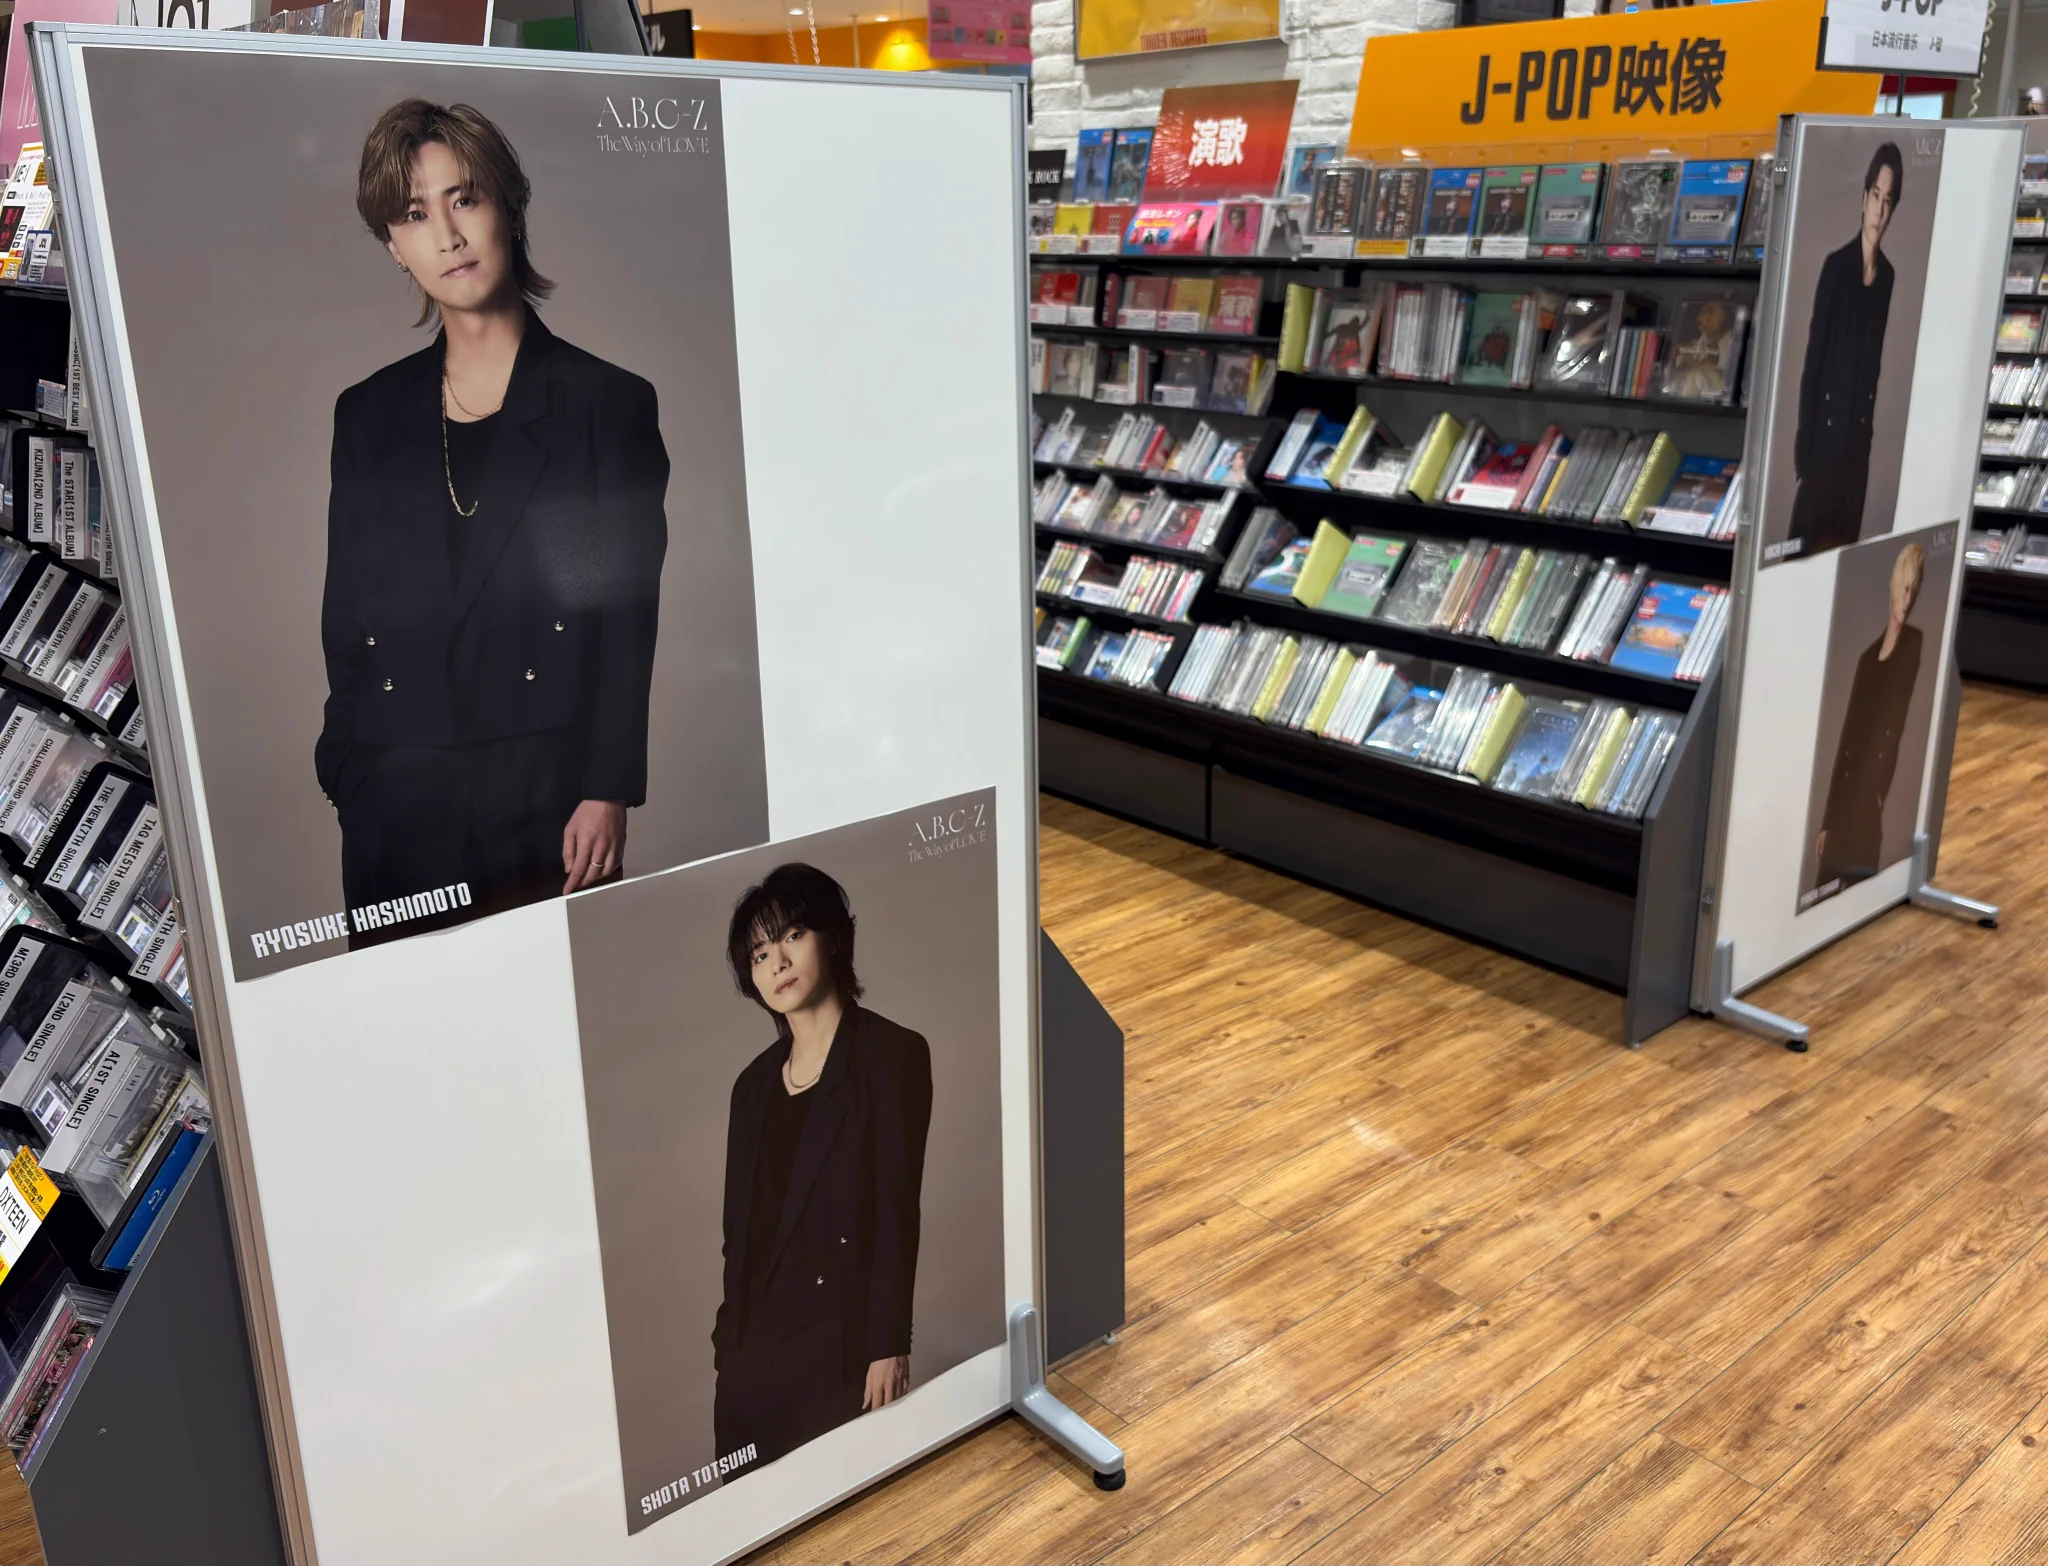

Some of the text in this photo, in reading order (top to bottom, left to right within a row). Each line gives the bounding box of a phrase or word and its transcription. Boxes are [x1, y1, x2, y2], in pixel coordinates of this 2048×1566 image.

[1459, 36, 1727, 126] J-POP映像
[596, 95, 708, 131] A.B.C-Z
[1187, 116, 1248, 168] 演歌
[71, 383, 80, 400] BEST
[64, 461, 74, 477] The
[108, 614, 126, 643] ROPICAL
[97, 785, 115, 804] THE
[138, 818, 157, 839] TAG
[908, 803, 986, 847] A.B.C-Z
[251, 881, 472, 959] RYOSUKE HASHIMOTO
[640, 1442, 758, 1515] SHOTA TOTSUKA
